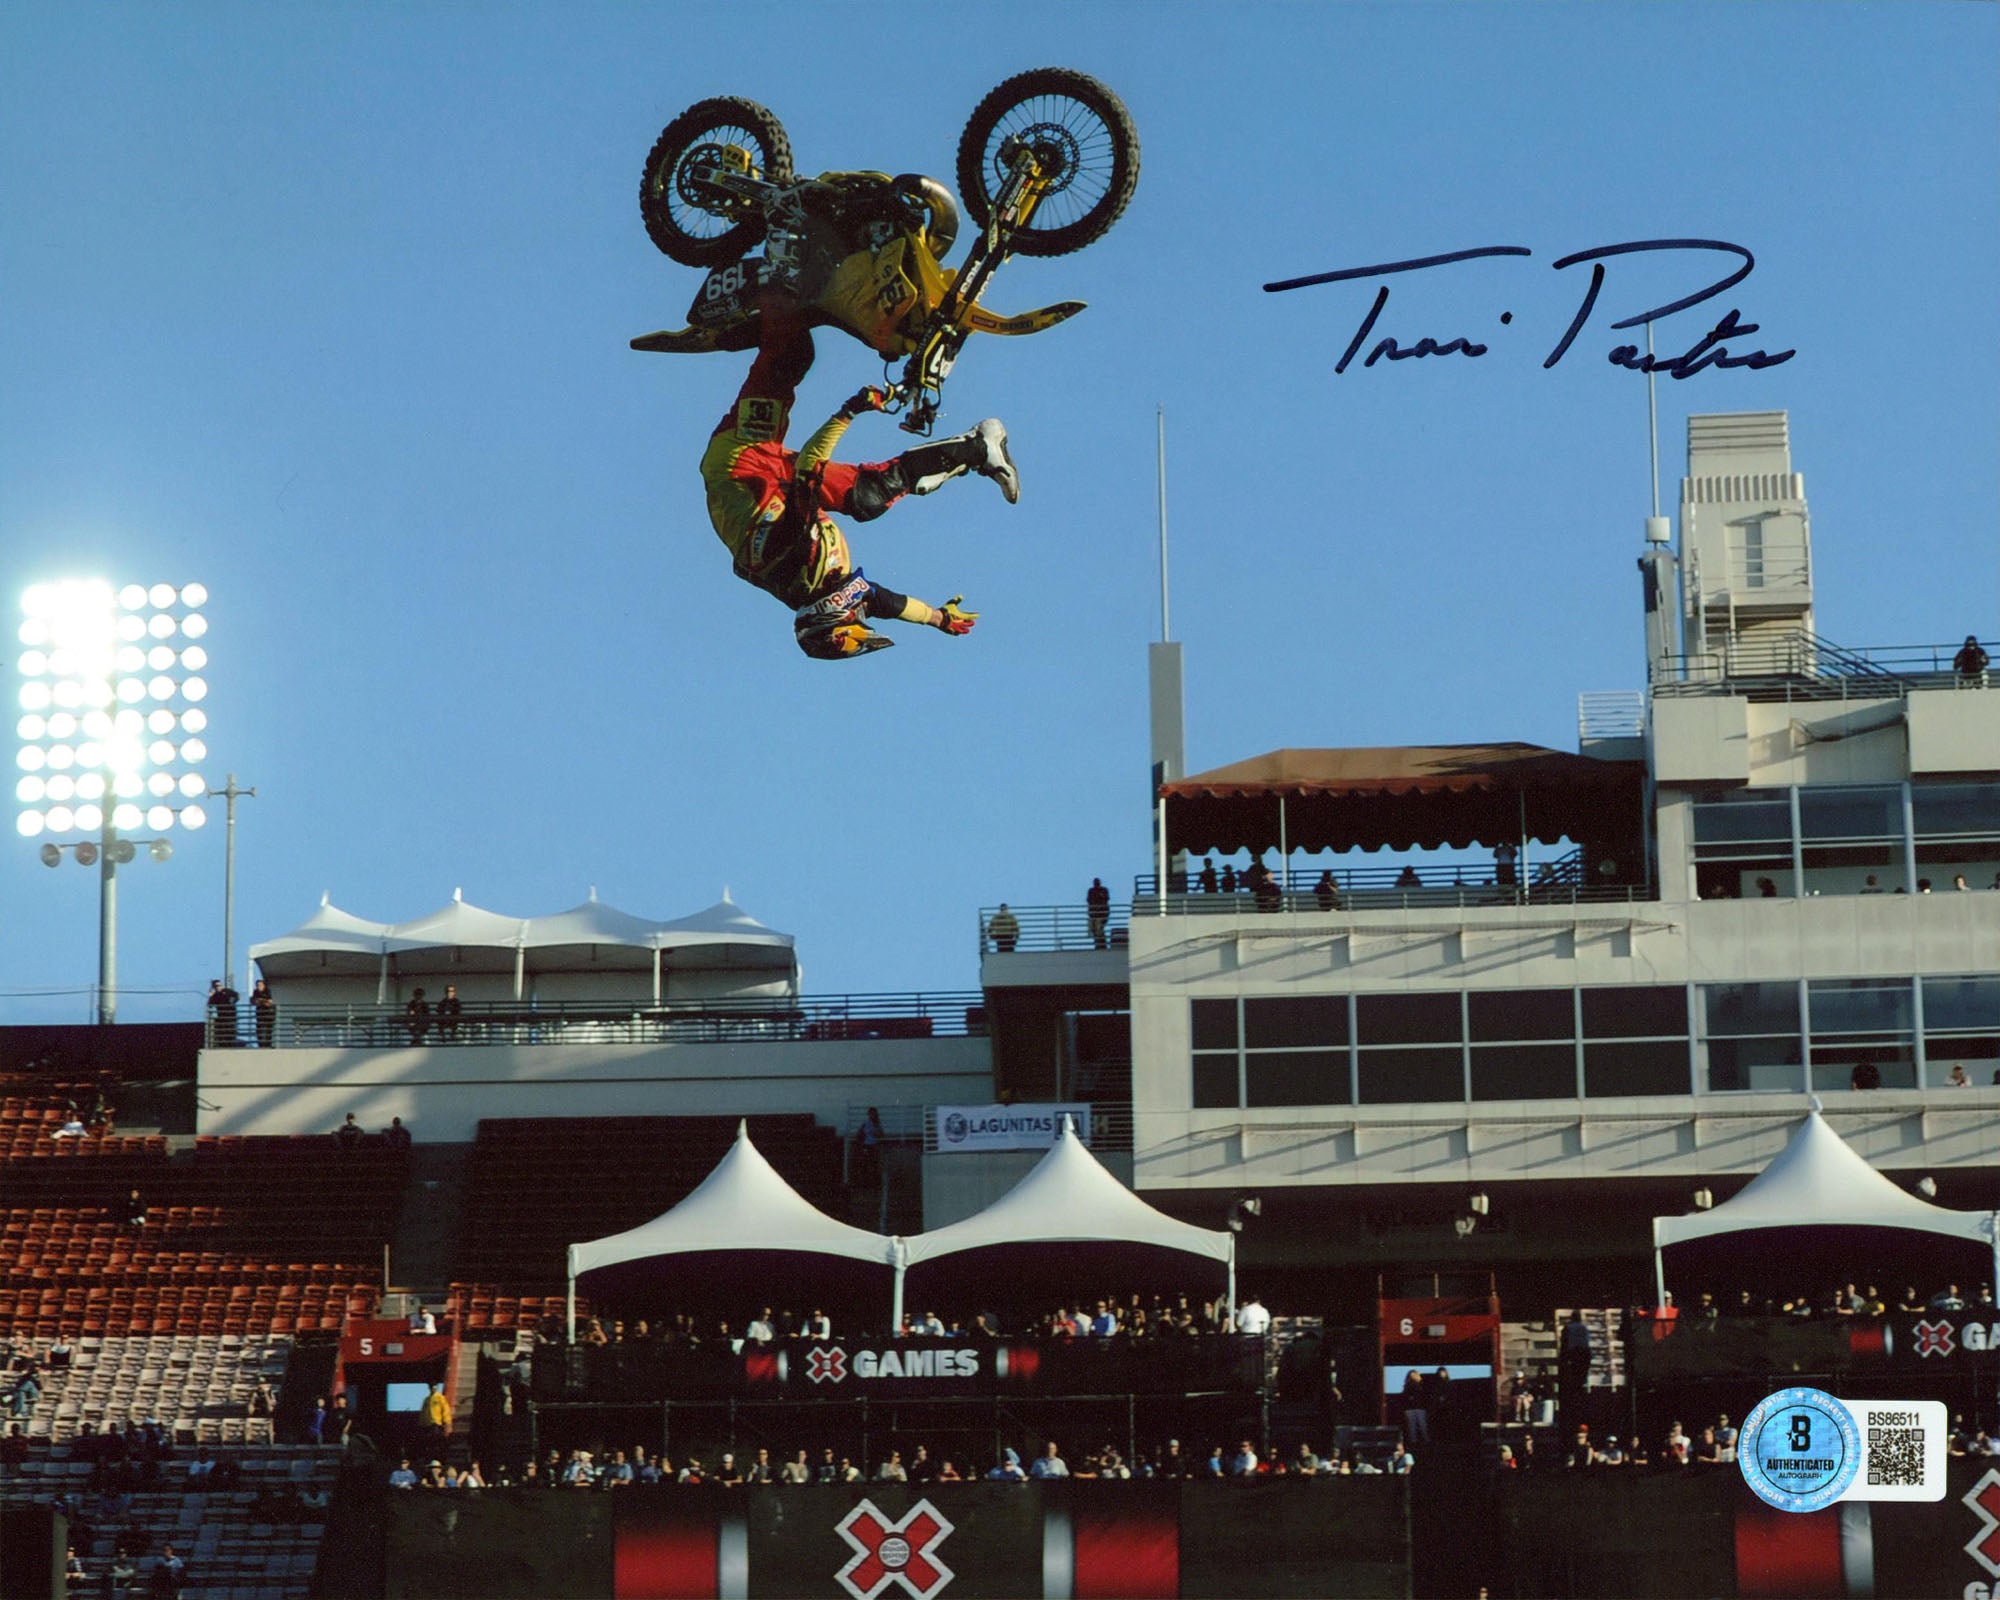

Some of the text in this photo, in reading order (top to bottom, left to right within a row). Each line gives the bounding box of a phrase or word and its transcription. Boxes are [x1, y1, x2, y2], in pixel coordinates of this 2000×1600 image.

[706, 262, 748, 300] 199
[815, 577, 869, 614] Red Bull
[969, 1117, 1053, 1133] LAGUNITAS
[1399, 1317, 1414, 1336] 6
[360, 1338, 373, 1355] 5
[852, 1349, 980, 1378] GAMES
